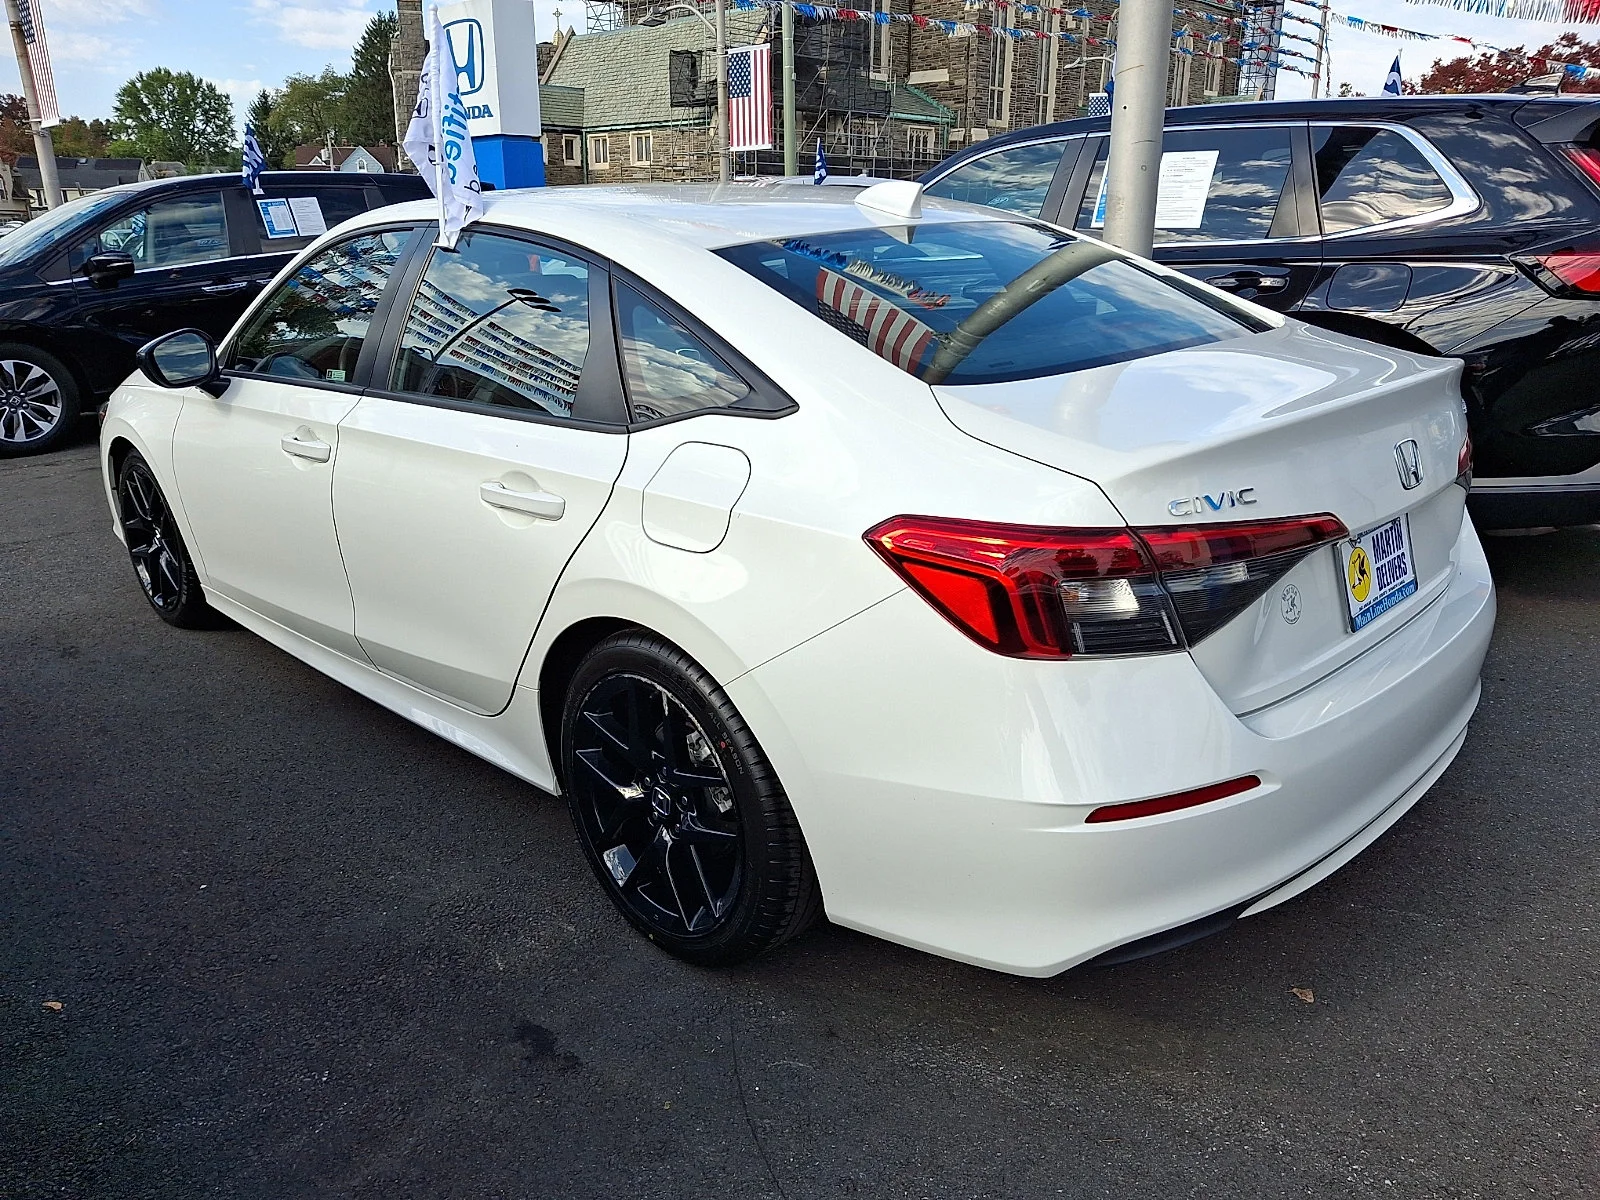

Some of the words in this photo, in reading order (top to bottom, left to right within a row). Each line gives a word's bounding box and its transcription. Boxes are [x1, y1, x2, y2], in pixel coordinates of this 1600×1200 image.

[1168, 487, 1258, 517] CIVIC
[1371, 520, 1404, 564] MARTIN
[1375, 551, 1408, 592] DELIVERS
